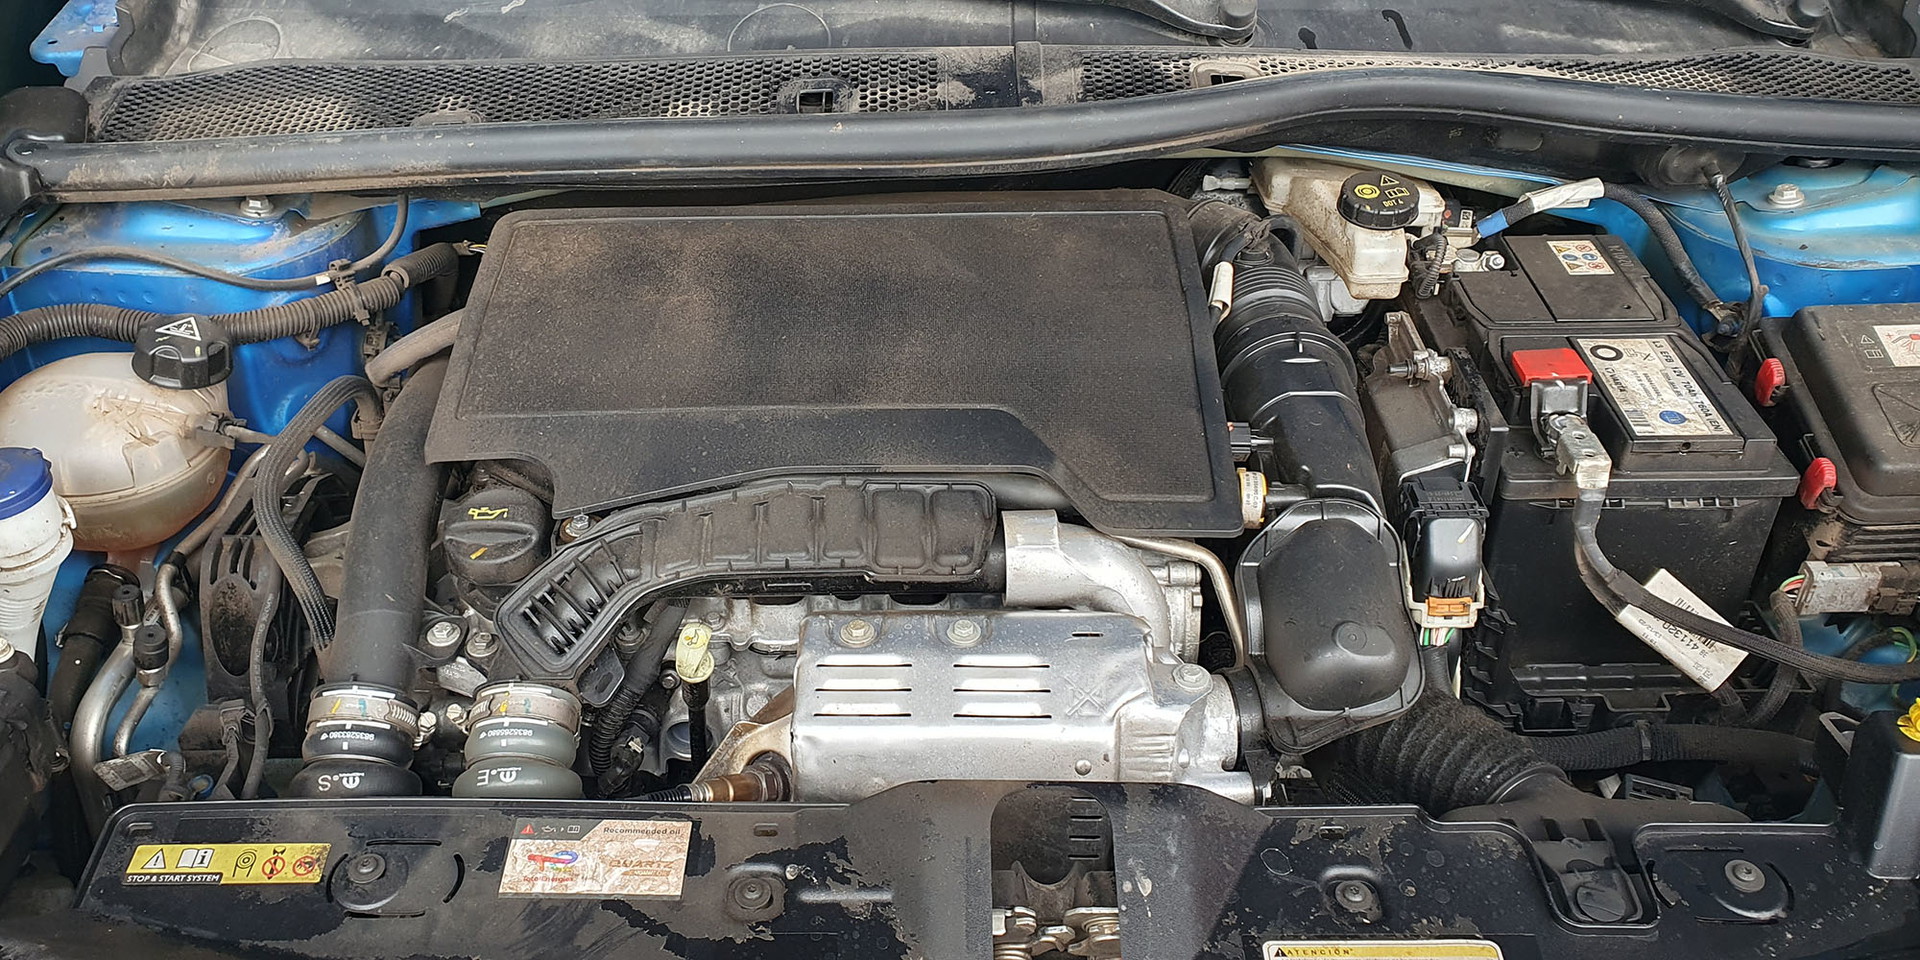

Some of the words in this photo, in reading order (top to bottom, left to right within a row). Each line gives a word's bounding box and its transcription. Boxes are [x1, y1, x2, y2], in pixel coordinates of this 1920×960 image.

[1652, 340, 1664, 348] L3
[1660, 351, 1674, 363] EFB
[1671, 367, 1686, 378] 12V
[1681, 381, 1699, 397] 70Ah
[1695, 401, 1712, 417] 760A
[1662, 622, 1699, 650] 411320
[603, 827, 667, 835] Recommended
[127, 875, 150, 883] STOP
